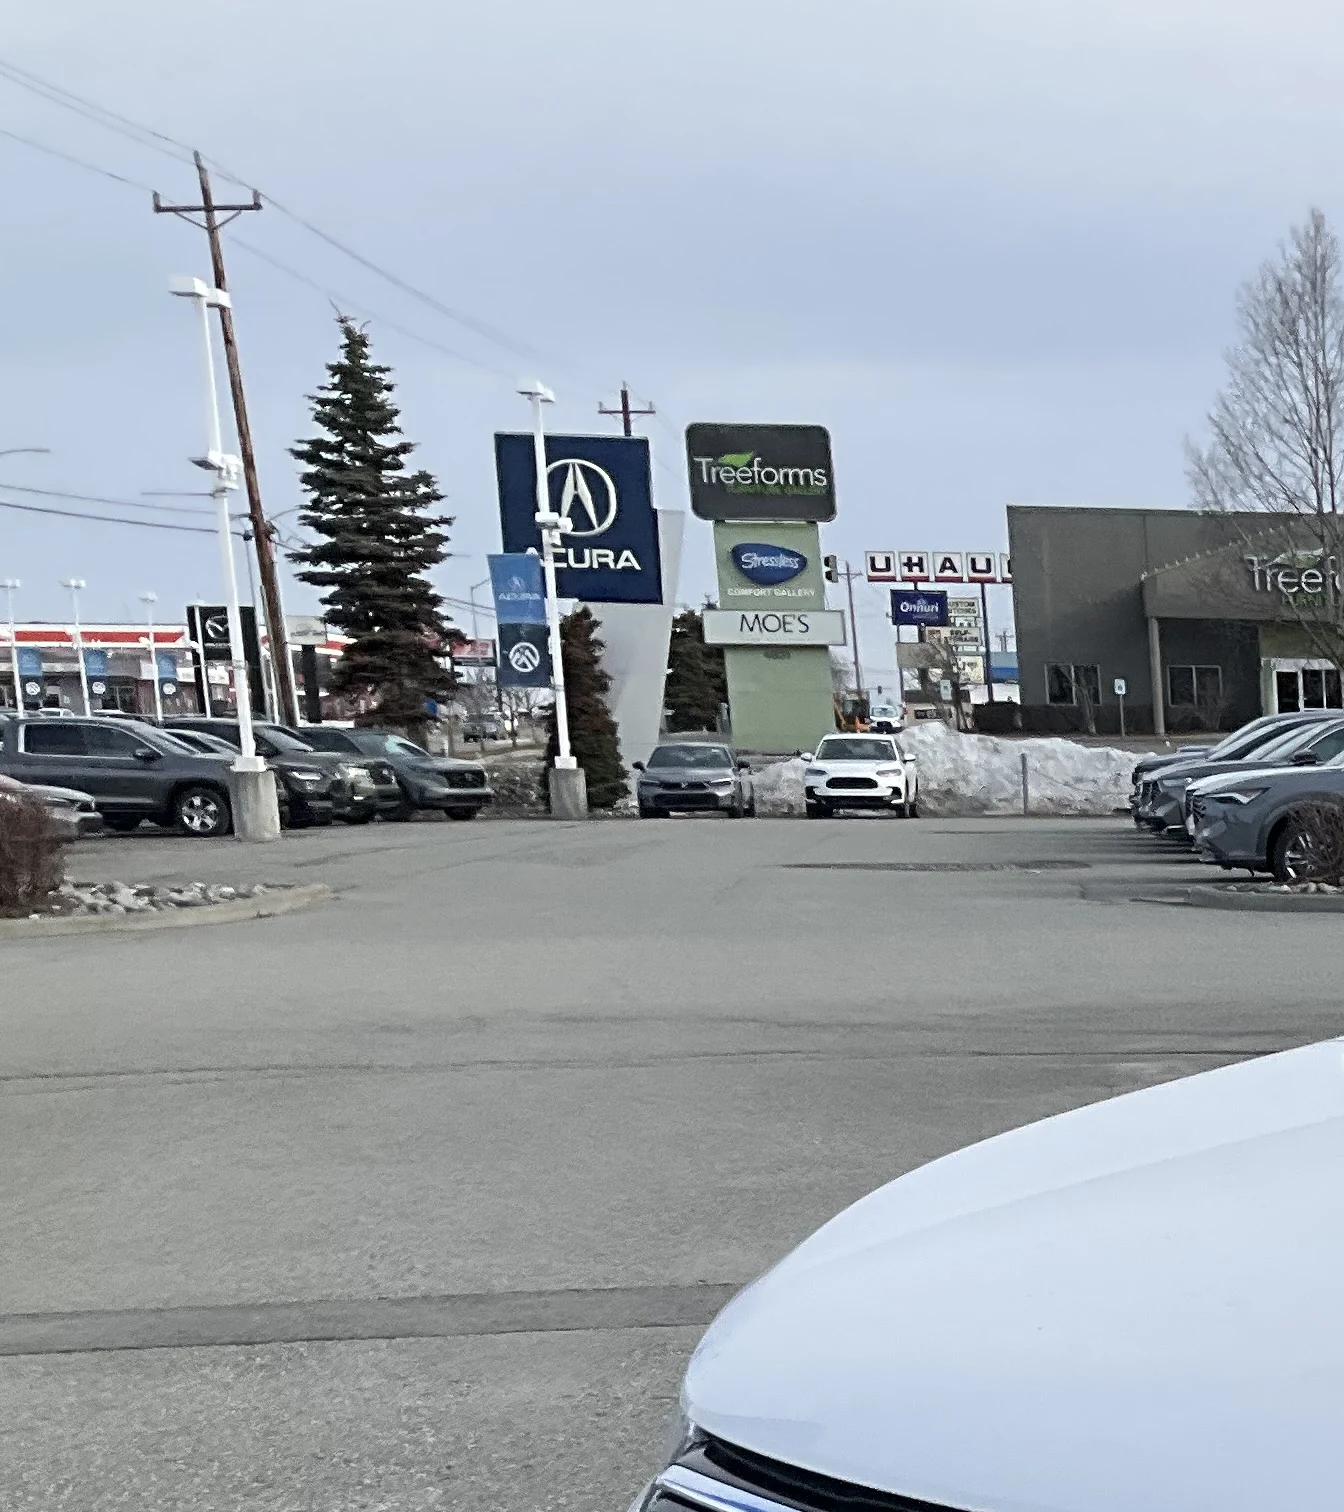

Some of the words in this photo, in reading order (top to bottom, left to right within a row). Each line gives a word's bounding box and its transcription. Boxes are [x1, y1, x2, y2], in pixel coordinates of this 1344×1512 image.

[693, 457, 828, 487] Treeforms
[741, 552, 800, 569] Stressless
[727, 588, 772, 598] COMFORT
[773, 588, 815, 598] GALLERY
[739, 613, 810, 634] MOE'S
